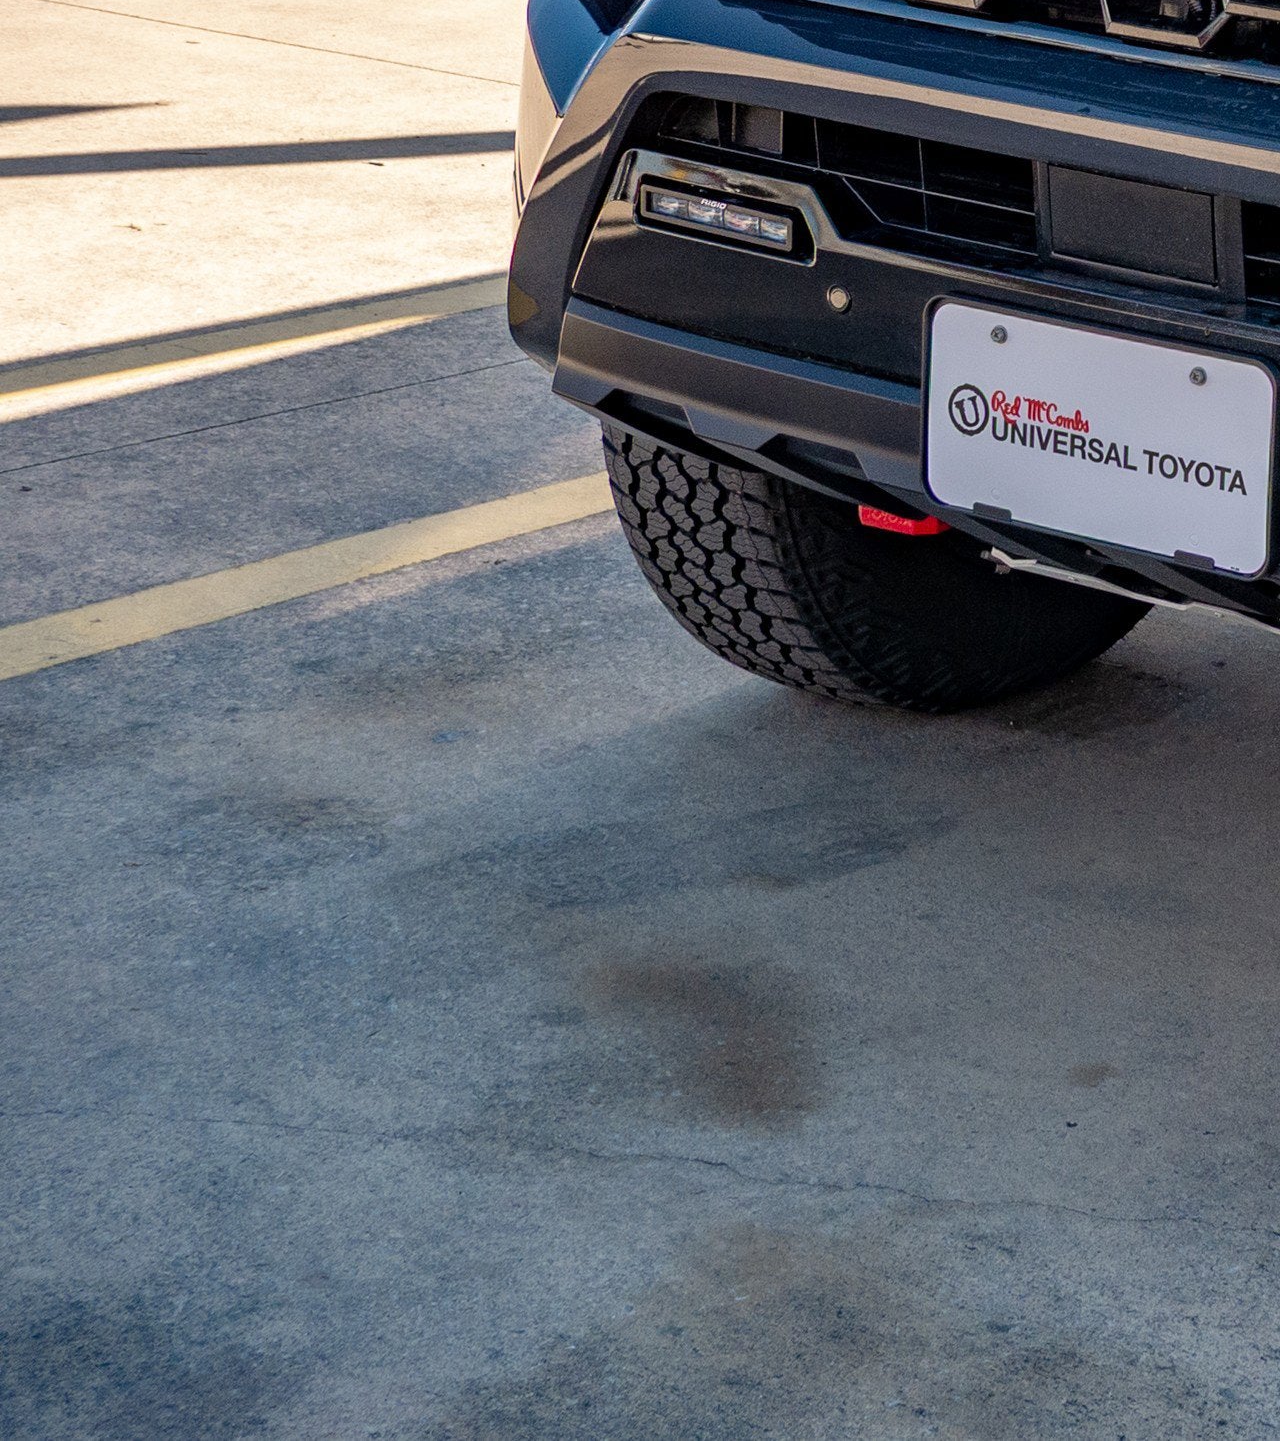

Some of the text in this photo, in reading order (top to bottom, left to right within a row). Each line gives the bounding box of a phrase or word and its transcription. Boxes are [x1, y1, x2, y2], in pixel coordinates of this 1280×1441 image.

[701, 198, 727, 210] RIGID
[991, 390, 1090, 434] Red McCombs
[991, 416, 1248, 496] UNIVERSAL TOYOTA
